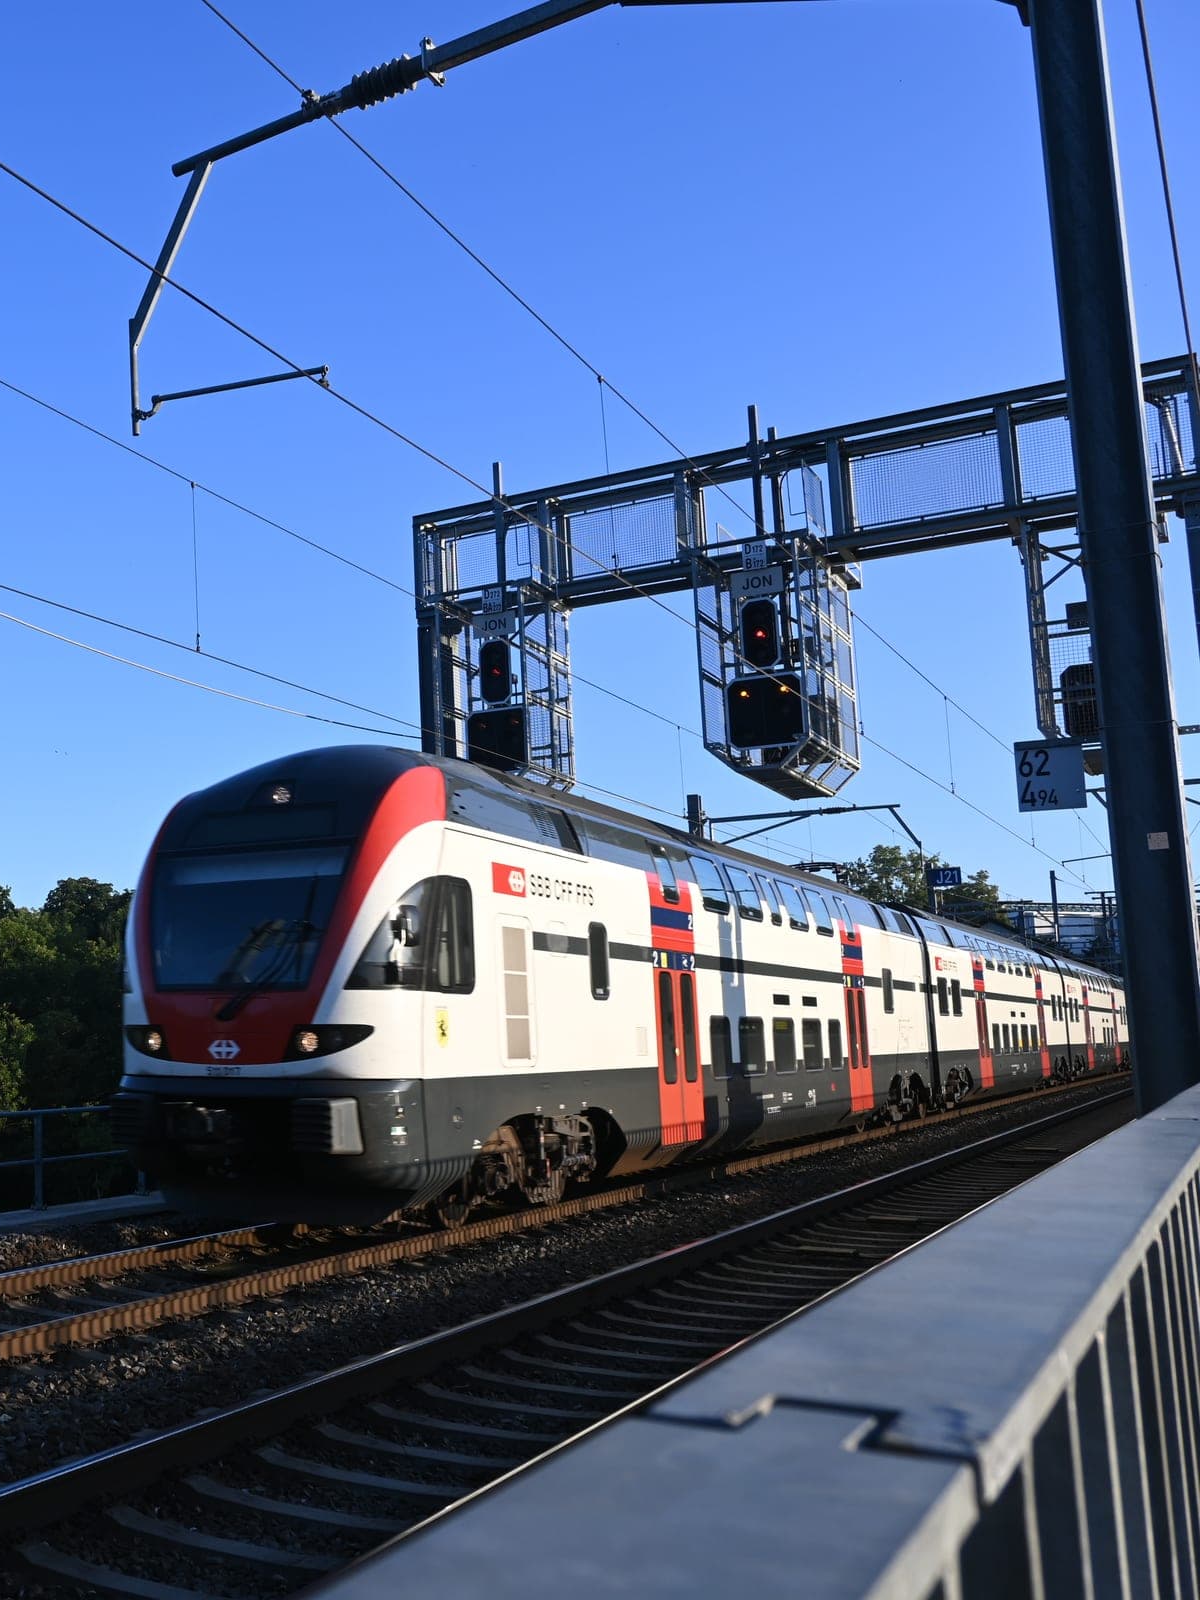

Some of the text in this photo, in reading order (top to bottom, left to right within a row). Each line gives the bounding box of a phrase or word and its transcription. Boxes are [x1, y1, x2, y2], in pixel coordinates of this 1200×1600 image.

[742, 574, 772, 590] JON
[481, 617, 506, 631] JON
[1019, 750, 1051, 777] 62
[1021, 781, 1058, 807] 494
[937, 870, 959, 884] J21
[530, 873, 594, 906] SBB CFF FFS
[687, 914, 693, 930] 2
[652, 950, 659, 968] 2
[690, 955, 696, 971] 2
